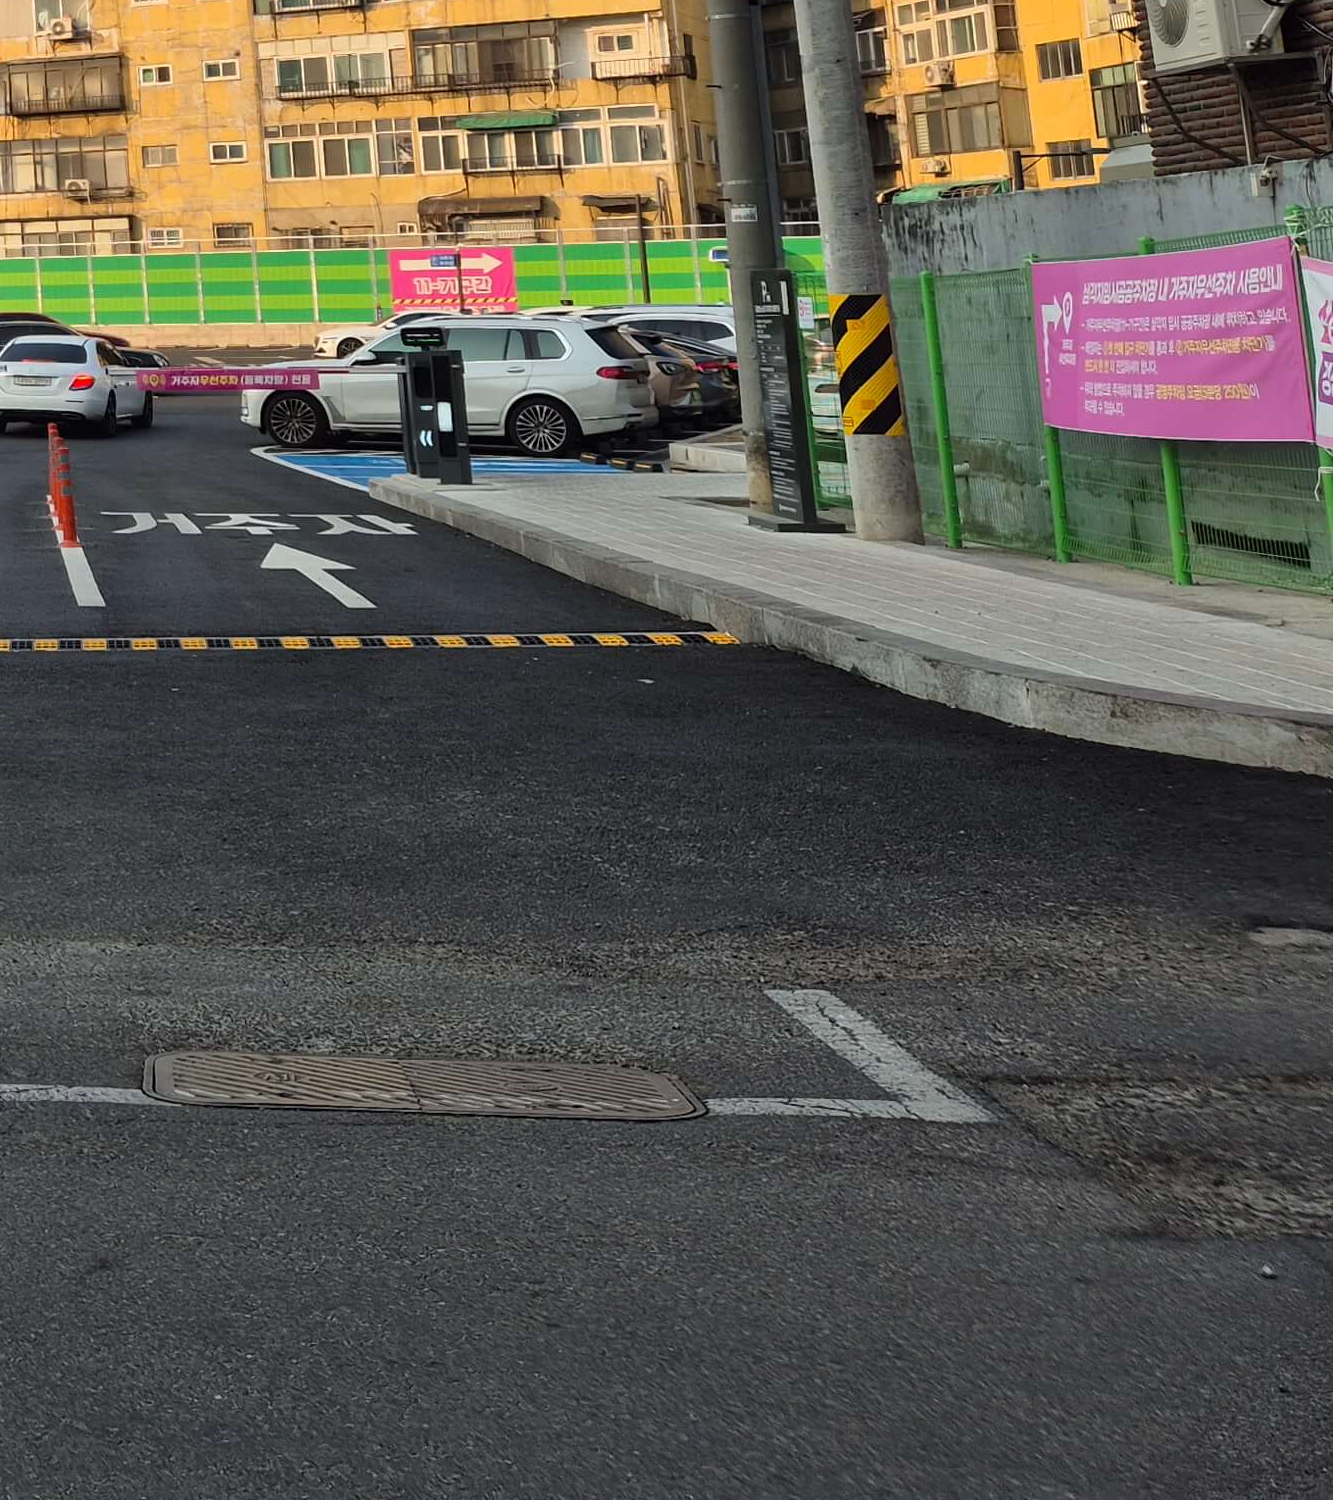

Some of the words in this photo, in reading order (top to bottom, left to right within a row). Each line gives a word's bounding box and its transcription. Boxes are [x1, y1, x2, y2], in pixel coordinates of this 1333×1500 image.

[1237, 264, 1283, 295] 사용안내
[171, 374, 238, 386] 거주자우선주차
[100, 511, 419, 536] 거주자
